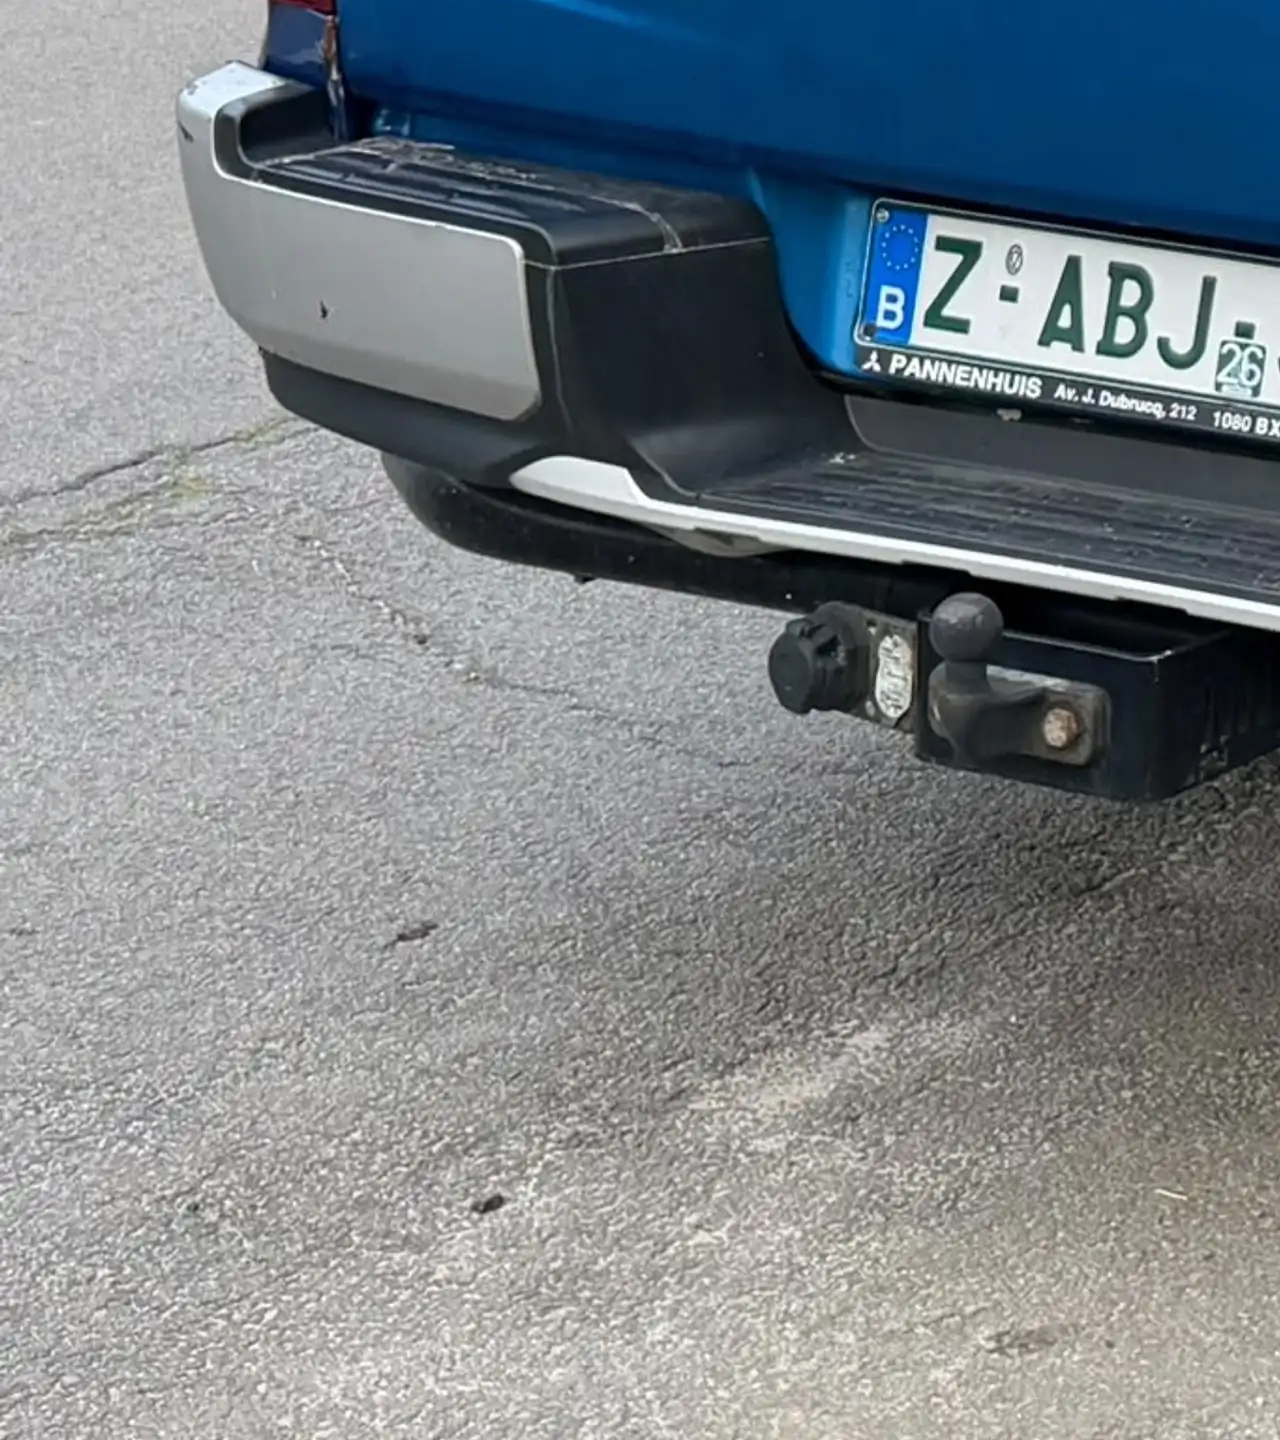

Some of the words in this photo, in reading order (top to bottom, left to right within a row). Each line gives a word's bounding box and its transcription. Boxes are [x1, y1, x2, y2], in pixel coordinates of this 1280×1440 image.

[876, 285, 905, 329] B
[1217, 343, 1263, 387] 26
[889, 353, 1042, 399] PANNENHUIS
[1054, 383, 1078, 402] Av.
[1081, 388, 1095, 404] J.
[1169, 403, 1197, 421] 212
[1213, 411, 1251, 432] 1080
